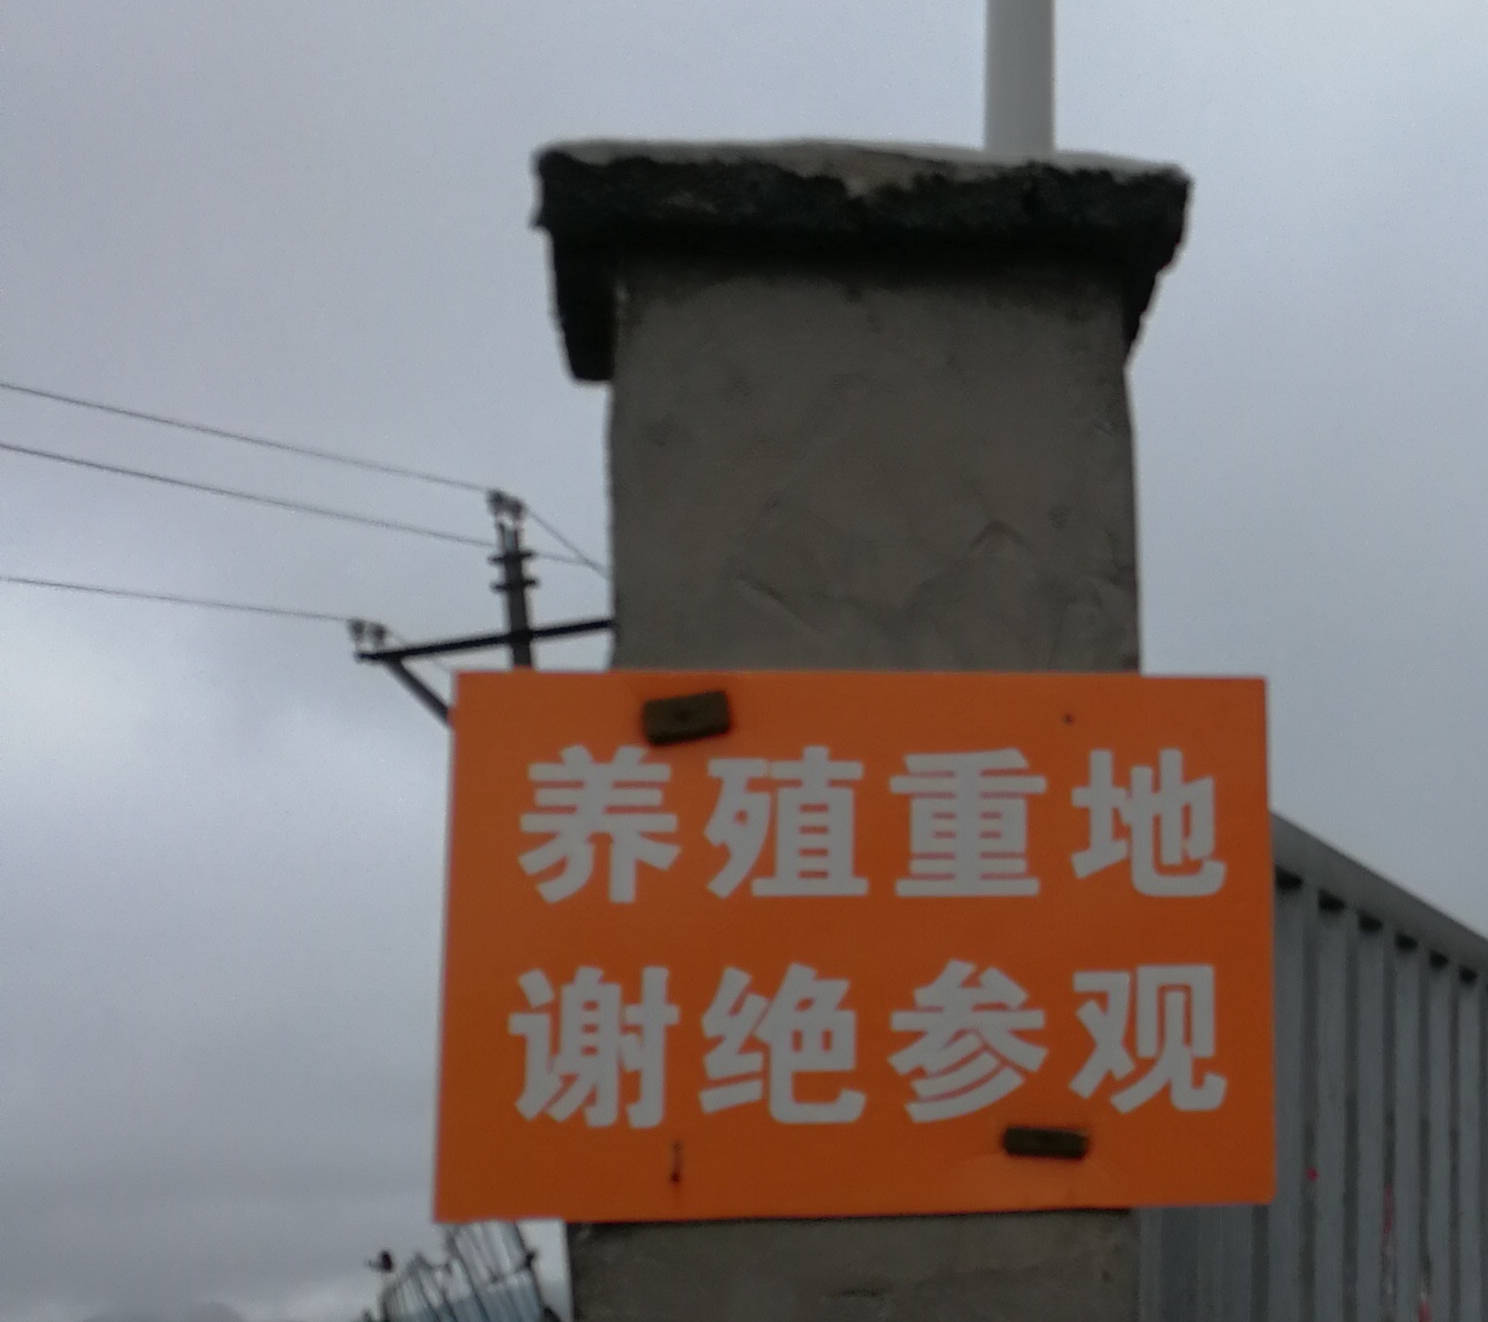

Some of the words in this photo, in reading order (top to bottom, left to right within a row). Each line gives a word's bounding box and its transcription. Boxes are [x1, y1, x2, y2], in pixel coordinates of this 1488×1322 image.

[517, 745, 1228, 904] 养殖重地
[508, 960, 1228, 1130] 谢绝参观
